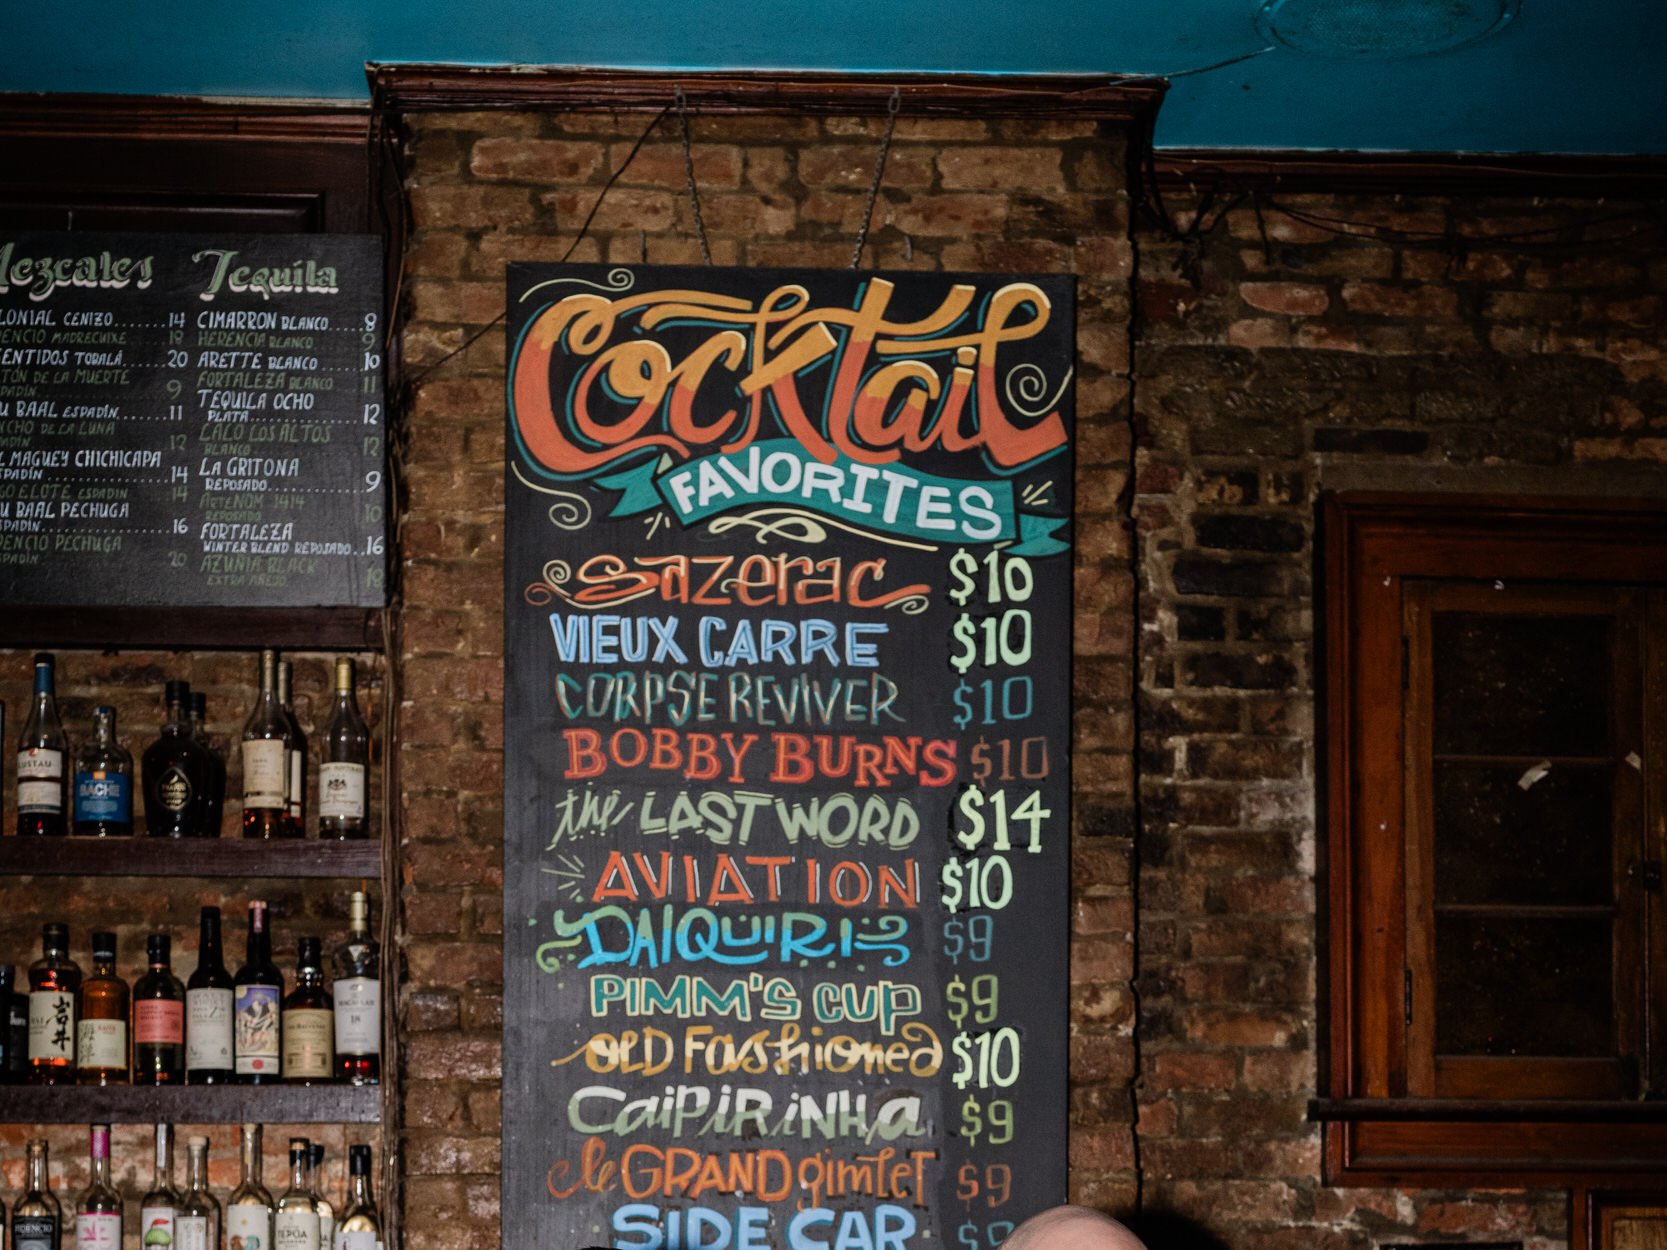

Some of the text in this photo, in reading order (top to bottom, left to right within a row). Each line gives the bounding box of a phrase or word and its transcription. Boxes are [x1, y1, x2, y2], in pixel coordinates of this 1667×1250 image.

[64, 311, 113, 326] CENIZO
[169, 311, 186, 328] 14
[197, 310, 377, 332] CIMARRON BLANCO 8
[169, 329, 184, 345] 18
[198, 331, 376, 352] HERENCIA BLANCO 9
[167, 349, 188, 368] 20
[197, 351, 380, 371] ARETTE BLANCO 10
[33, 371, 49, 384] DE
[53, 371, 70, 384] LA
[73, 369, 130, 385] MUERTE
[197, 370, 376, 393] FORTALEZA BLANCO 11
[166, 379, 182, 400] 9
[196, 388, 315, 410] TEQUILA OCHO
[16, 400, 58, 418] BAAL
[62, 404, 120, 419] ESPADÍN
[169, 405, 182, 421] 11
[208, 403, 380, 425] PLATA 12
[41, 423, 52, 435] DE
[78, 421, 116, 435] LUNA
[198, 422, 332, 442] LALO LOS ALTOS
[169, 433, 187, 451] 12
[363, 436, 379, 456] 12
[9, 450, 70, 467] MAGUEY
[74, 449, 161, 467] CHICHICAPA
[226, 456, 300, 477] GRITONA
[171, 465, 188, 484] 14
[205, 470, 381, 493] REPOSADO 9
[18, 483, 71, 499] ELOTE
[172, 485, 188, 502] 14
[668, 446, 1004, 540] FAVORITES
[16, 501, 56, 519] BAAL
[60, 501, 130, 519] PECHUGA
[364, 503, 382, 523] 10
[173, 517, 189, 535] 16
[200, 521, 294, 541] FORTALEZA
[54, 535, 122, 552] PECHUGA
[203, 535, 384, 556] WINTER BLEND REPOSADO 16
[168, 550, 188, 568] 20
[948, 548, 1034, 605] $10
[549, 609, 1032, 674] VIEUX CARRE $10
[555, 671, 1034, 729] CORPSE REVIVER $10
[563, 727, 1050, 788] BOBBY BURNS $10
[546, 782, 1052, 853] the LAST WORD $14
[592, 851, 1014, 912] AVIATION $10
[943, 914, 994, 964] $9
[590, 971, 802, 1023] PIMM'S
[946, 973, 1000, 1030] $9
[952, 1027, 1021, 1090] $10
[960, 1095, 1015, 1147] $9
[621, 1143, 792, 1203] GRAND
[956, 1159, 1013, 1212] $9
